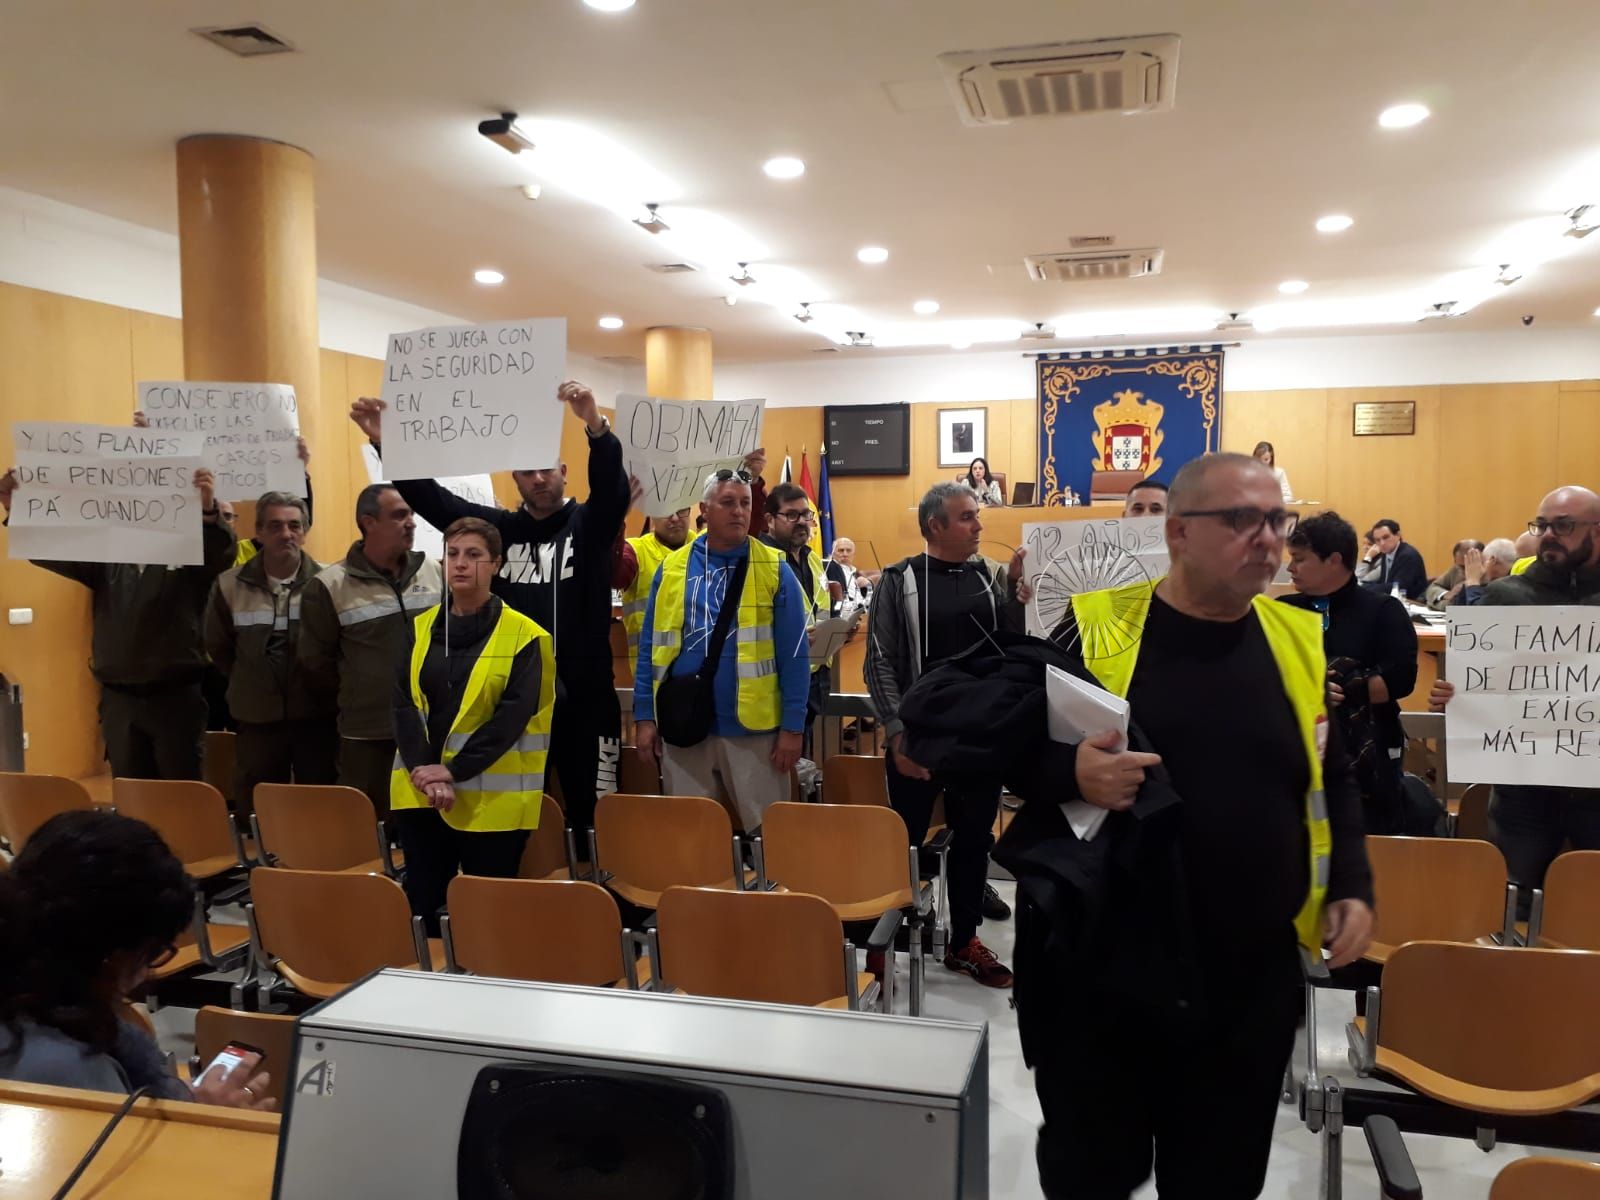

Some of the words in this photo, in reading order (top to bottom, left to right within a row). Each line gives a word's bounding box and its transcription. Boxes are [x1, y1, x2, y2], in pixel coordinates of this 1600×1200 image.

[394, 336, 413, 355] NO
[419, 331, 437, 350] SE
[448, 329, 488, 349] JUEGA
[497, 327, 533, 345] CON
[389, 364, 414, 382] LA
[420, 351, 535, 380] SEGURIDAD
[395, 392, 422, 412] EN
[452, 390, 482, 409] EL
[400, 413, 519, 443] TRABAJO
[22, 430, 34, 445] Y
[46, 431, 84, 454] LOS
[98, 432, 181, 456] PLANES
[19, 466, 50, 484] DE
[69, 462, 188, 489] PENSIONES
[28, 496, 61, 518] PÁ
[1027, 526, 1067, 566] 12
[1514, 621, 1600, 653] FAMI
[1465, 666, 1497, 691] DE
[1522, 696, 1600, 723] EXIG
[1483, 724, 1536, 756] MÁS
